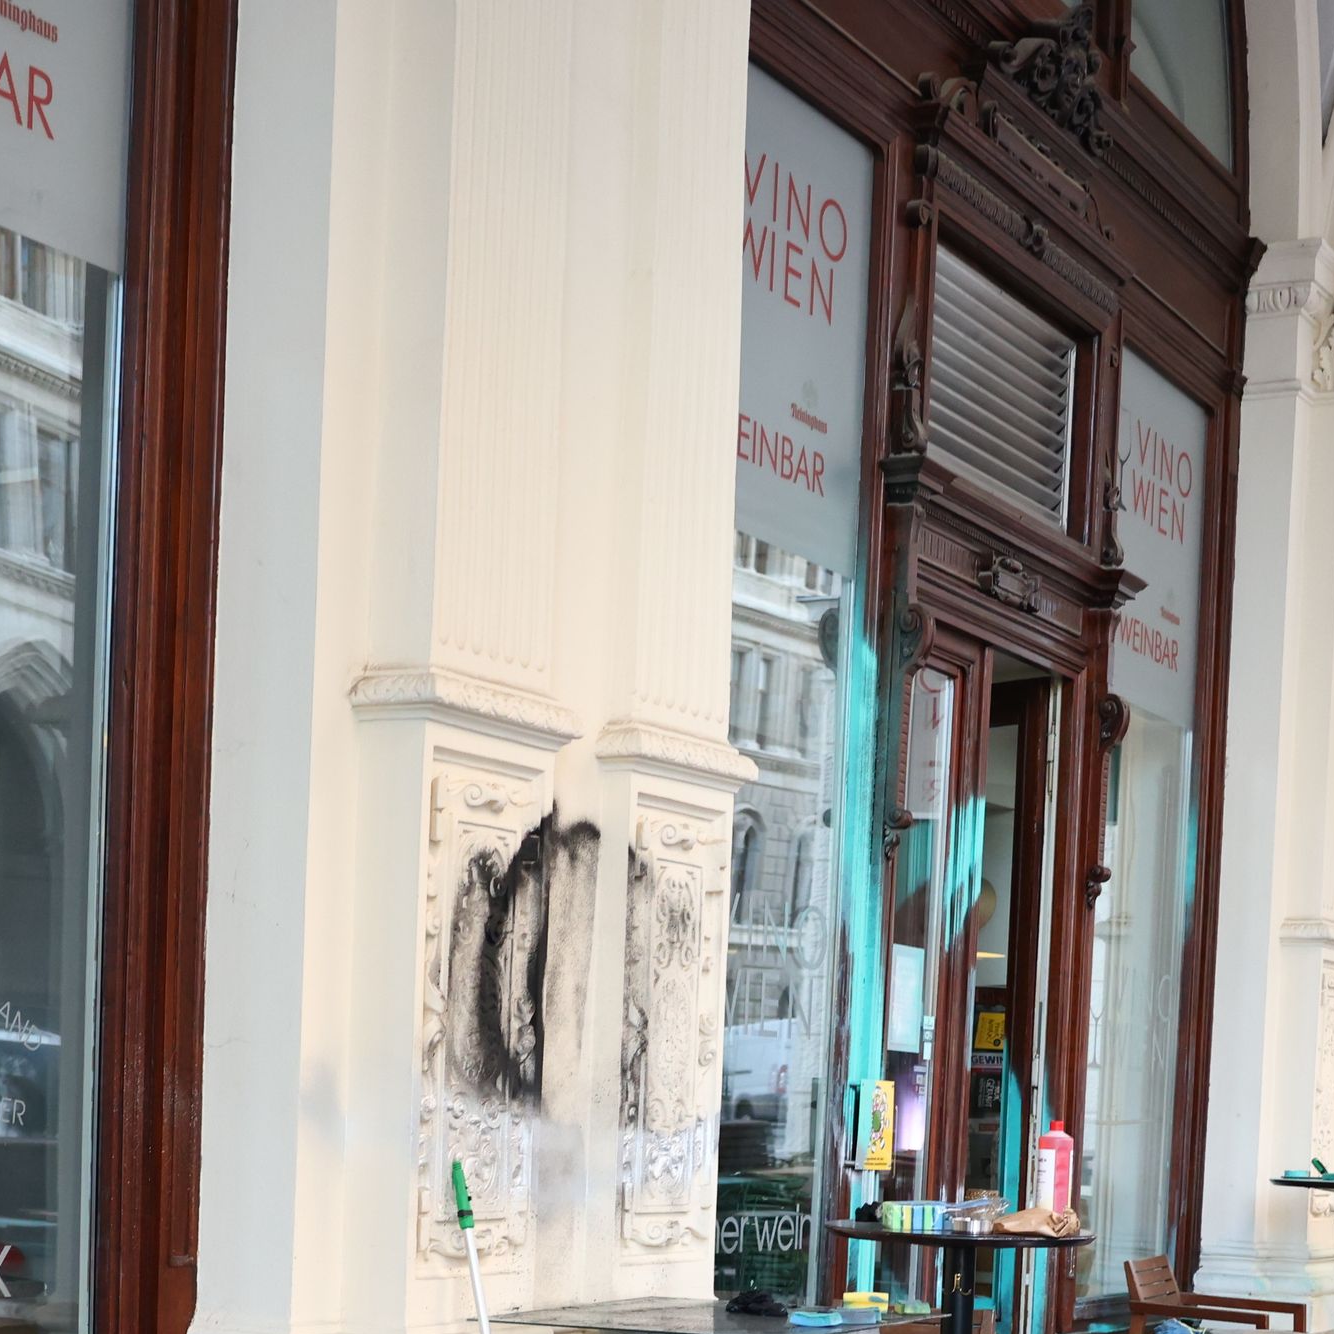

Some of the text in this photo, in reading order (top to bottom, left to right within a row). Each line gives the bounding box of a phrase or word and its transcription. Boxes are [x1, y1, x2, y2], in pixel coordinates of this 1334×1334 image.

[744, 153, 847, 262] VINO
[1137, 419, 1192, 497] VINO
[1132, 468, 1185, 545] WIEN
[1120, 612, 1179, 673] WEINBAR
